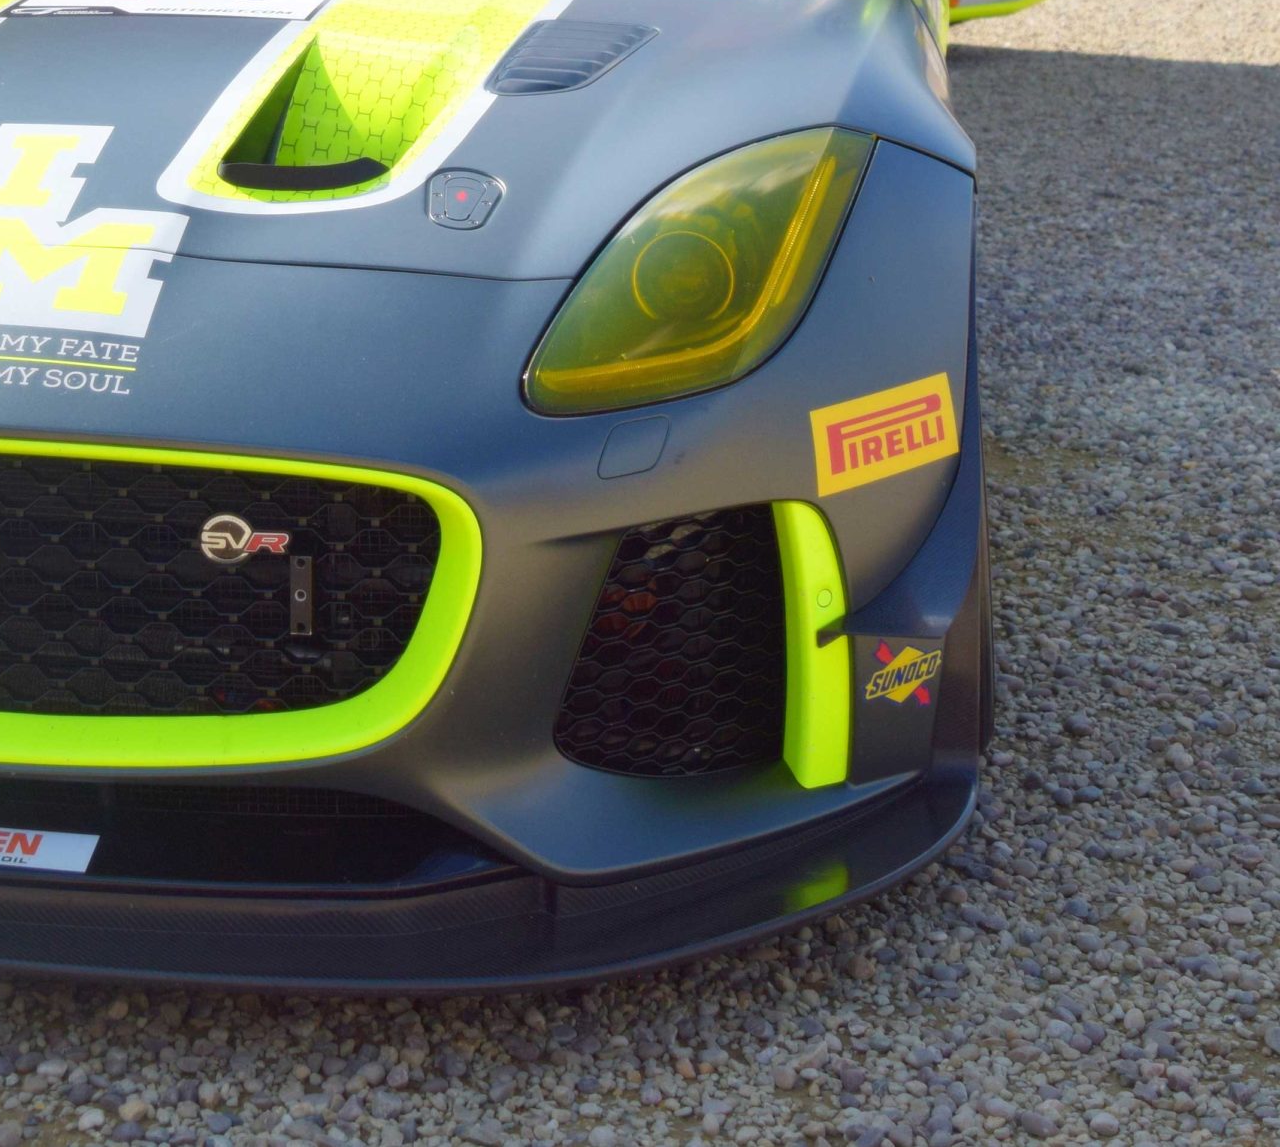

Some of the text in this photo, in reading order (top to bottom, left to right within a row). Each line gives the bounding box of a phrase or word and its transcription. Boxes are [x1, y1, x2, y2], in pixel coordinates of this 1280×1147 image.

[56, 338, 141, 363] FATE
[42, 369, 132, 395] SOUL
[826, 392, 946, 476] PIRELLI
[200, 528, 289, 555] SVR
[867, 651, 941, 698] SUNOCO
[1, 854, 28, 864] OIL
